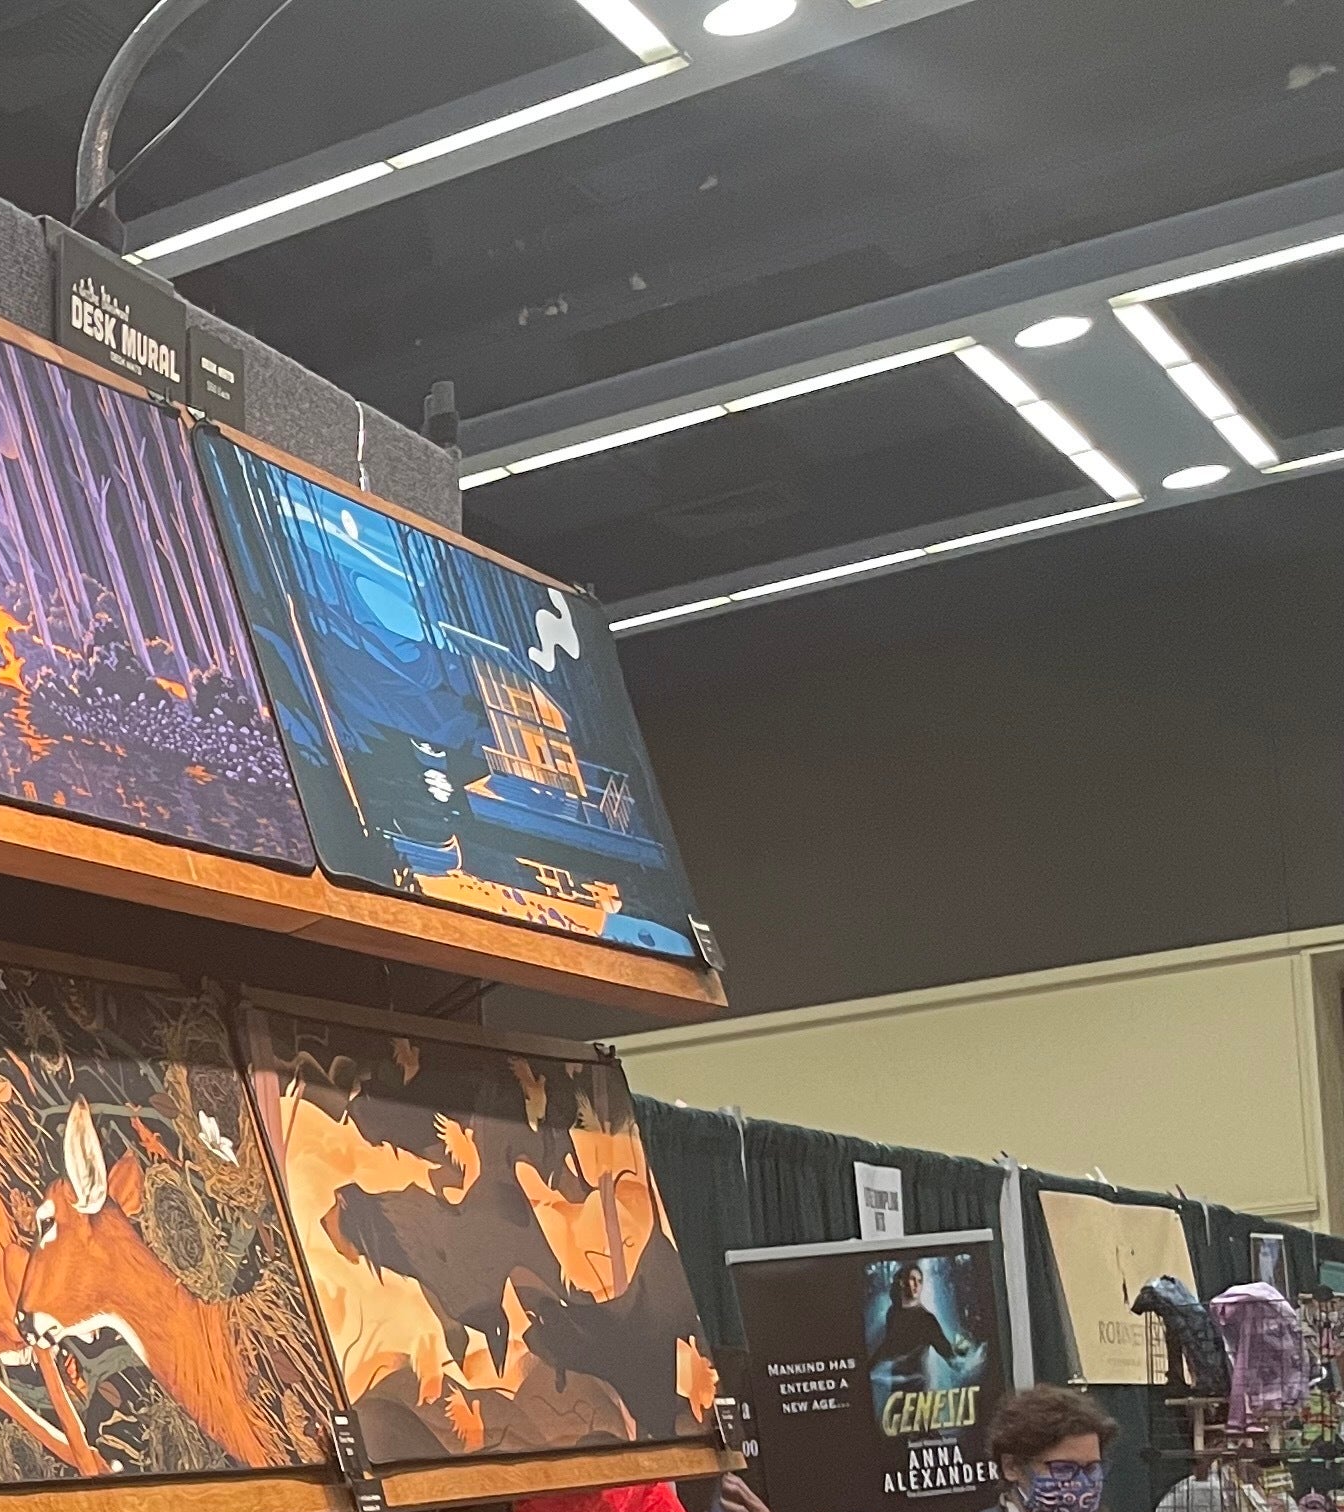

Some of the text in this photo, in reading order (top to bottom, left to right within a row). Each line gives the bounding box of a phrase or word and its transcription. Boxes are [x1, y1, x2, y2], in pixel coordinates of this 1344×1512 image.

[71, 294, 117, 349] DESK
[121, 323, 181, 383] MURAL
[779, 1378, 849, 1395] ENTERED A
[782, 1401, 808, 1414] NEW
[882, 1386, 980, 1436] GENESIS
[909, 1445, 963, 1470] ANNA
[884, 1461, 1000, 1493] ALEXANDER
